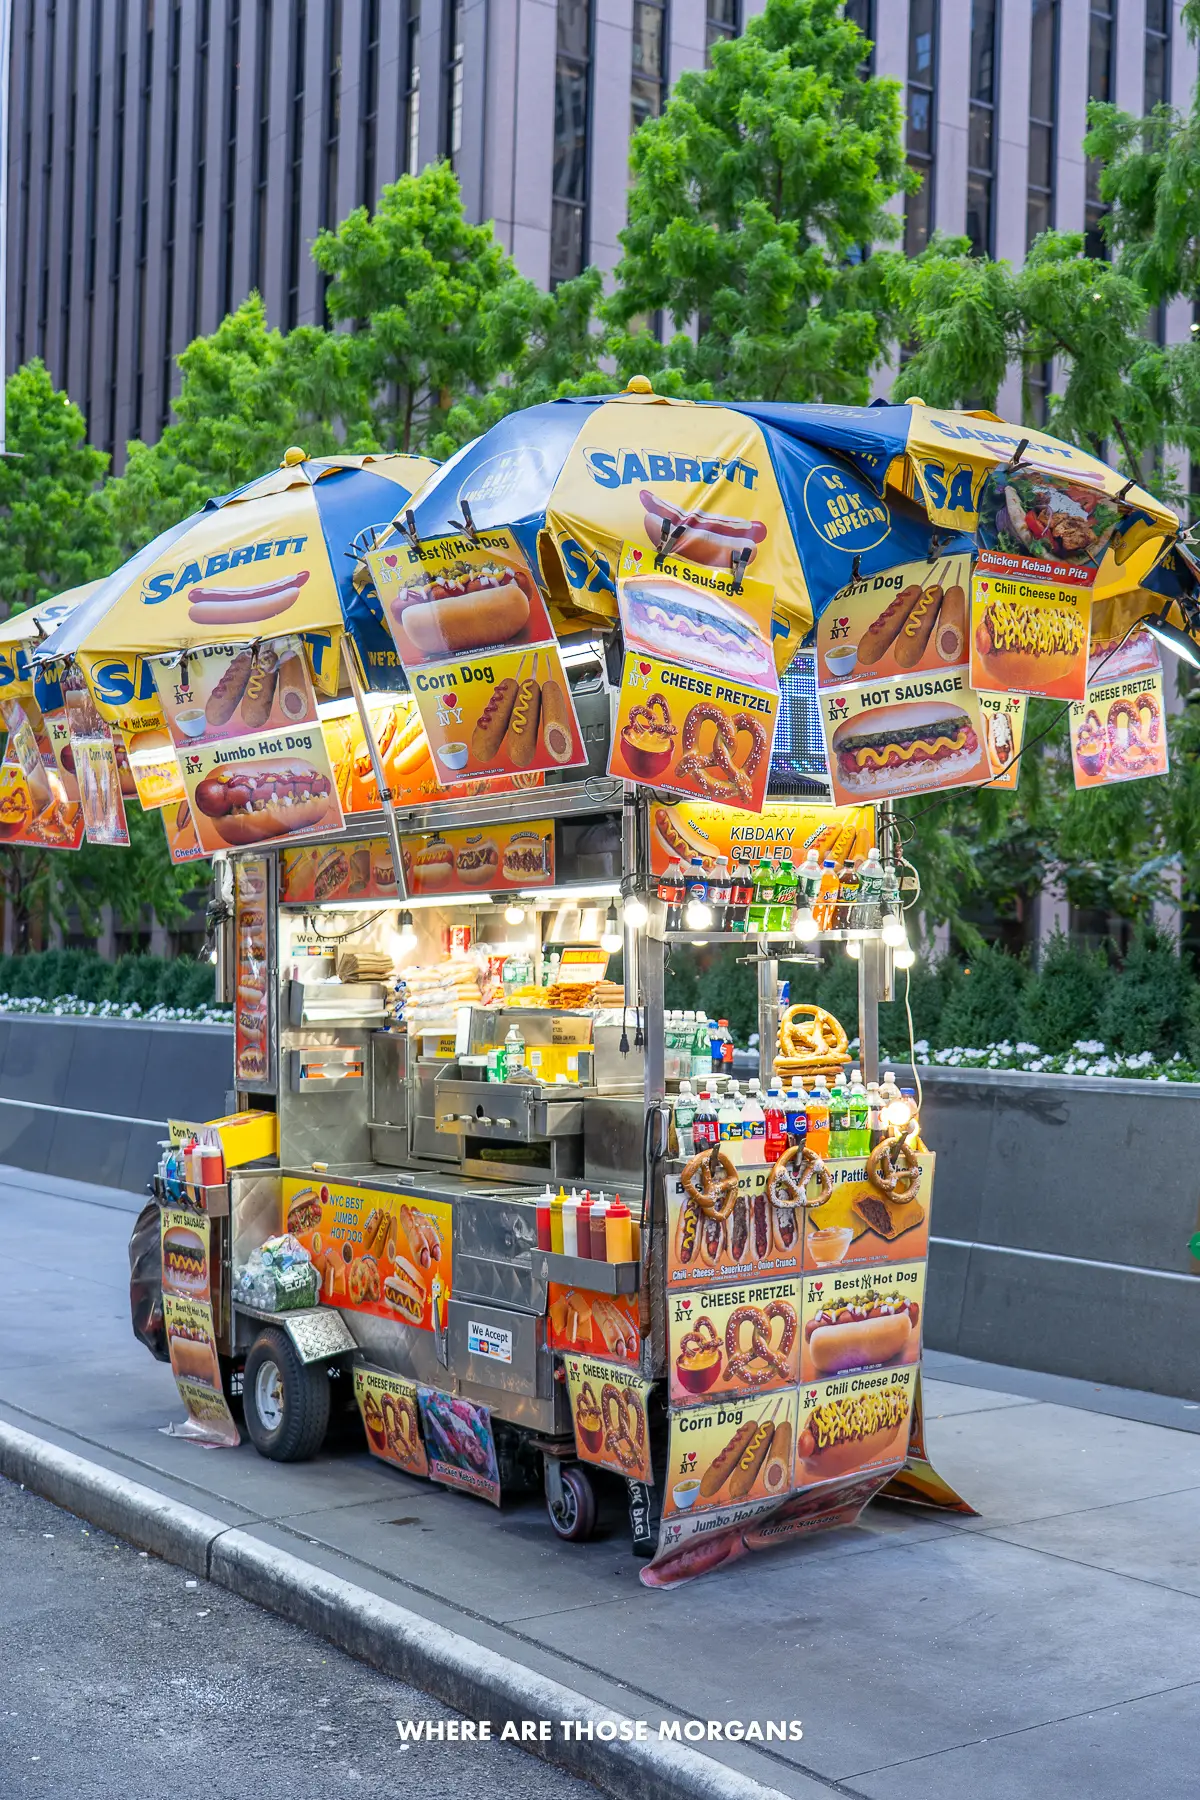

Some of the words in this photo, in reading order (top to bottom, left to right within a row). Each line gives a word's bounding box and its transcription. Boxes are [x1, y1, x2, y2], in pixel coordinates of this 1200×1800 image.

[930, 418, 1072, 459] SABRETT
[583, 447, 758, 490] SABRETT
[406, 547, 439, 564] Best
[455, 538, 480, 554] Hot
[480, 536, 510, 549] Dog
[141, 534, 308, 604] SABRETT
[981, 552, 1019, 568] Chicken
[1021, 559, 1051, 573] Kebab
[1054, 567, 1066, 575] on
[1068, 567, 1088, 580] Pita
[654, 560, 678, 578] Hot
[682, 567, 744, 596] Sausage
[833, 581, 868, 601] Corn
[874, 575, 903, 590] Dog
[994, 582, 1016, 595] Chili
[1019, 585, 1055, 601] Cheese
[1058, 591, 1078, 605] Dog
[833, 618, 838, 629] I
[830, 627, 850, 640] NY
[203, 645, 234, 658] Dog
[633, 660, 639, 673] I
[416, 673, 458, 691] Corn
[460, 665, 495, 684] Dog
[628, 672, 652, 690] NY
[173, 692, 193, 705] NY
[660, 670, 713, 697] CHEESE
[715, 687, 773, 715] PRETZEL
[861, 690, 891, 707] HOT
[895, 677, 963, 701] SAUSAGE
[1089, 687, 1120, 703] CHEESE
[1122, 678, 1157, 696] PRETZEL
[433, 695, 443, 711] I
[828, 699, 834, 710] I
[1005, 705, 1020, 713] NY
[436, 707, 463, 727] NY
[828, 708, 849, 721] NY
[54, 731, 67, 739] NY
[213, 748, 255, 764] Jumbo
[258, 740, 282, 755] Hot
[286, 735, 312, 749] Dog
[186, 763, 203, 774] NY
[730, 826, 796, 841] KIBDAKY
[731, 846, 793, 860] GRILLED
[297, 935, 312, 943] We
[172, 1126, 186, 1138] Corn
[187, 1129, 198, 1144] Dog
[841, 1168, 868, 1183] Pattie
[330, 1194, 344, 1206] NYC
[346, 1196, 364, 1210] BEST
[173, 1213, 182, 1224] HOT
[184, 1214, 205, 1230] SAUSAGE
[333, 1212, 358, 1226] JUMBO
[330, 1227, 345, 1240] HOT
[348, 1229, 363, 1244] DOG
[672, 1270, 686, 1280] Chili
[692, 1267, 715, 1278] Cheese
[720, 1264, 753, 1274] Sauerkraut
[775, 1257, 797, 1268] Crunch
[834, 1279, 860, 1290] Best
[873, 1274, 893, 1285] Hot
[896, 1272, 917, 1283] Dog
[701, 1291, 745, 1309] CHEESE
[749, 1285, 796, 1302] PRETZEL
[808, 1291, 824, 1303] NY
[176, 1303, 187, 1312] Best
[200, 1309, 210, 1321] Dog
[675, 1310, 693, 1322] NY
[472, 1324, 483, 1336] We
[485, 1328, 508, 1343] Accept
[367, 1375, 388, 1391] CHEESE
[570, 1370, 580, 1382] NY
[583, 1363, 609, 1381] CHEESE
[610, 1371, 644, 1389] PRETZEL
[826, 1384, 849, 1397] Chili
[850, 1377, 887, 1392] Cheese
[890, 1372, 910, 1386] Dog
[804, 1398, 817, 1408] NY
[680, 1414, 712, 1433] Corn
[717, 1409, 743, 1425] Dog
[436, 1462, 458, 1477] Chicken
[680, 1461, 697, 1474] NY
[633, 1508, 645, 1535] BAG
[692, 1515, 730, 1533] Jumbo
[732, 1508, 754, 1522] Hot
[759, 1523, 794, 1537] Italian
[796, 1515, 842, 1528] Sausage
[665, 1533, 682, 1544] NY
